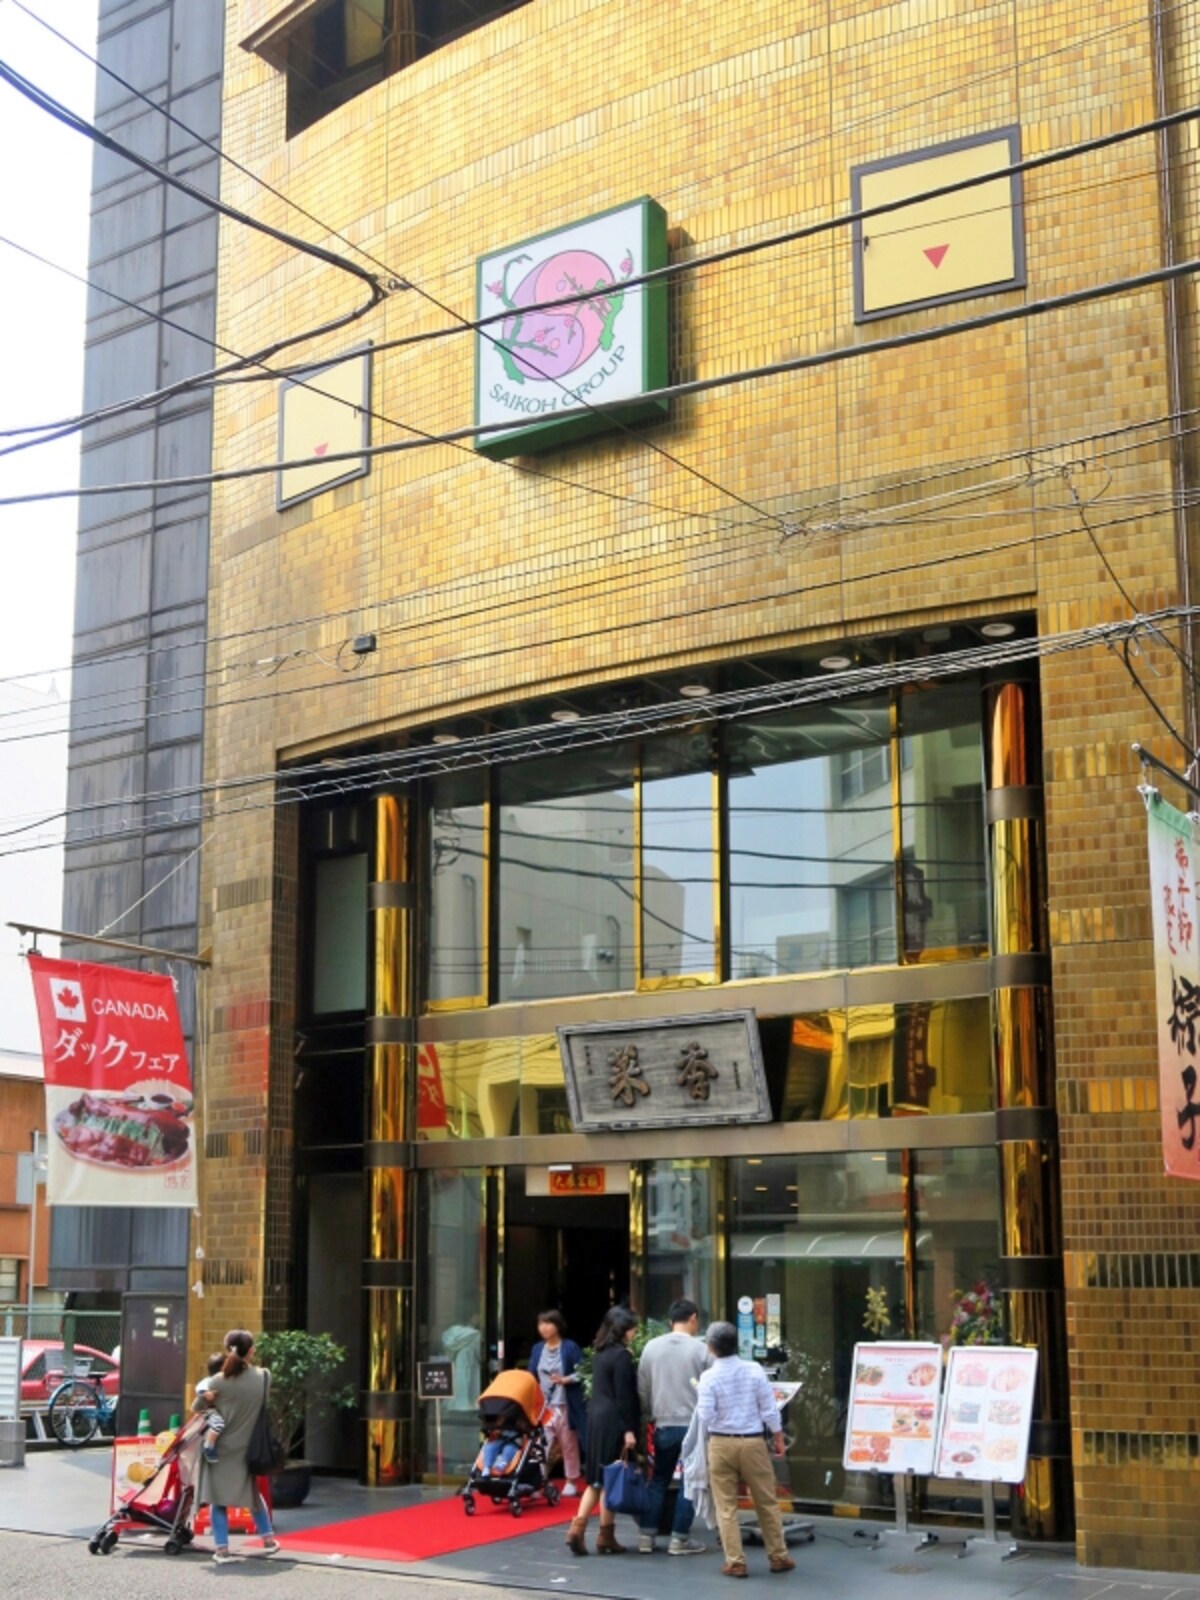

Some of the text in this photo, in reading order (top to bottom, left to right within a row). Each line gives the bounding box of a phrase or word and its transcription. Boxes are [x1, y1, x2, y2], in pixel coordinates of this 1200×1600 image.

[489, 344, 626, 414] SAIKOH GROUP
[91, 998, 169, 1022] CANADA
[54, 1027, 181, 1073] ダックフェア
